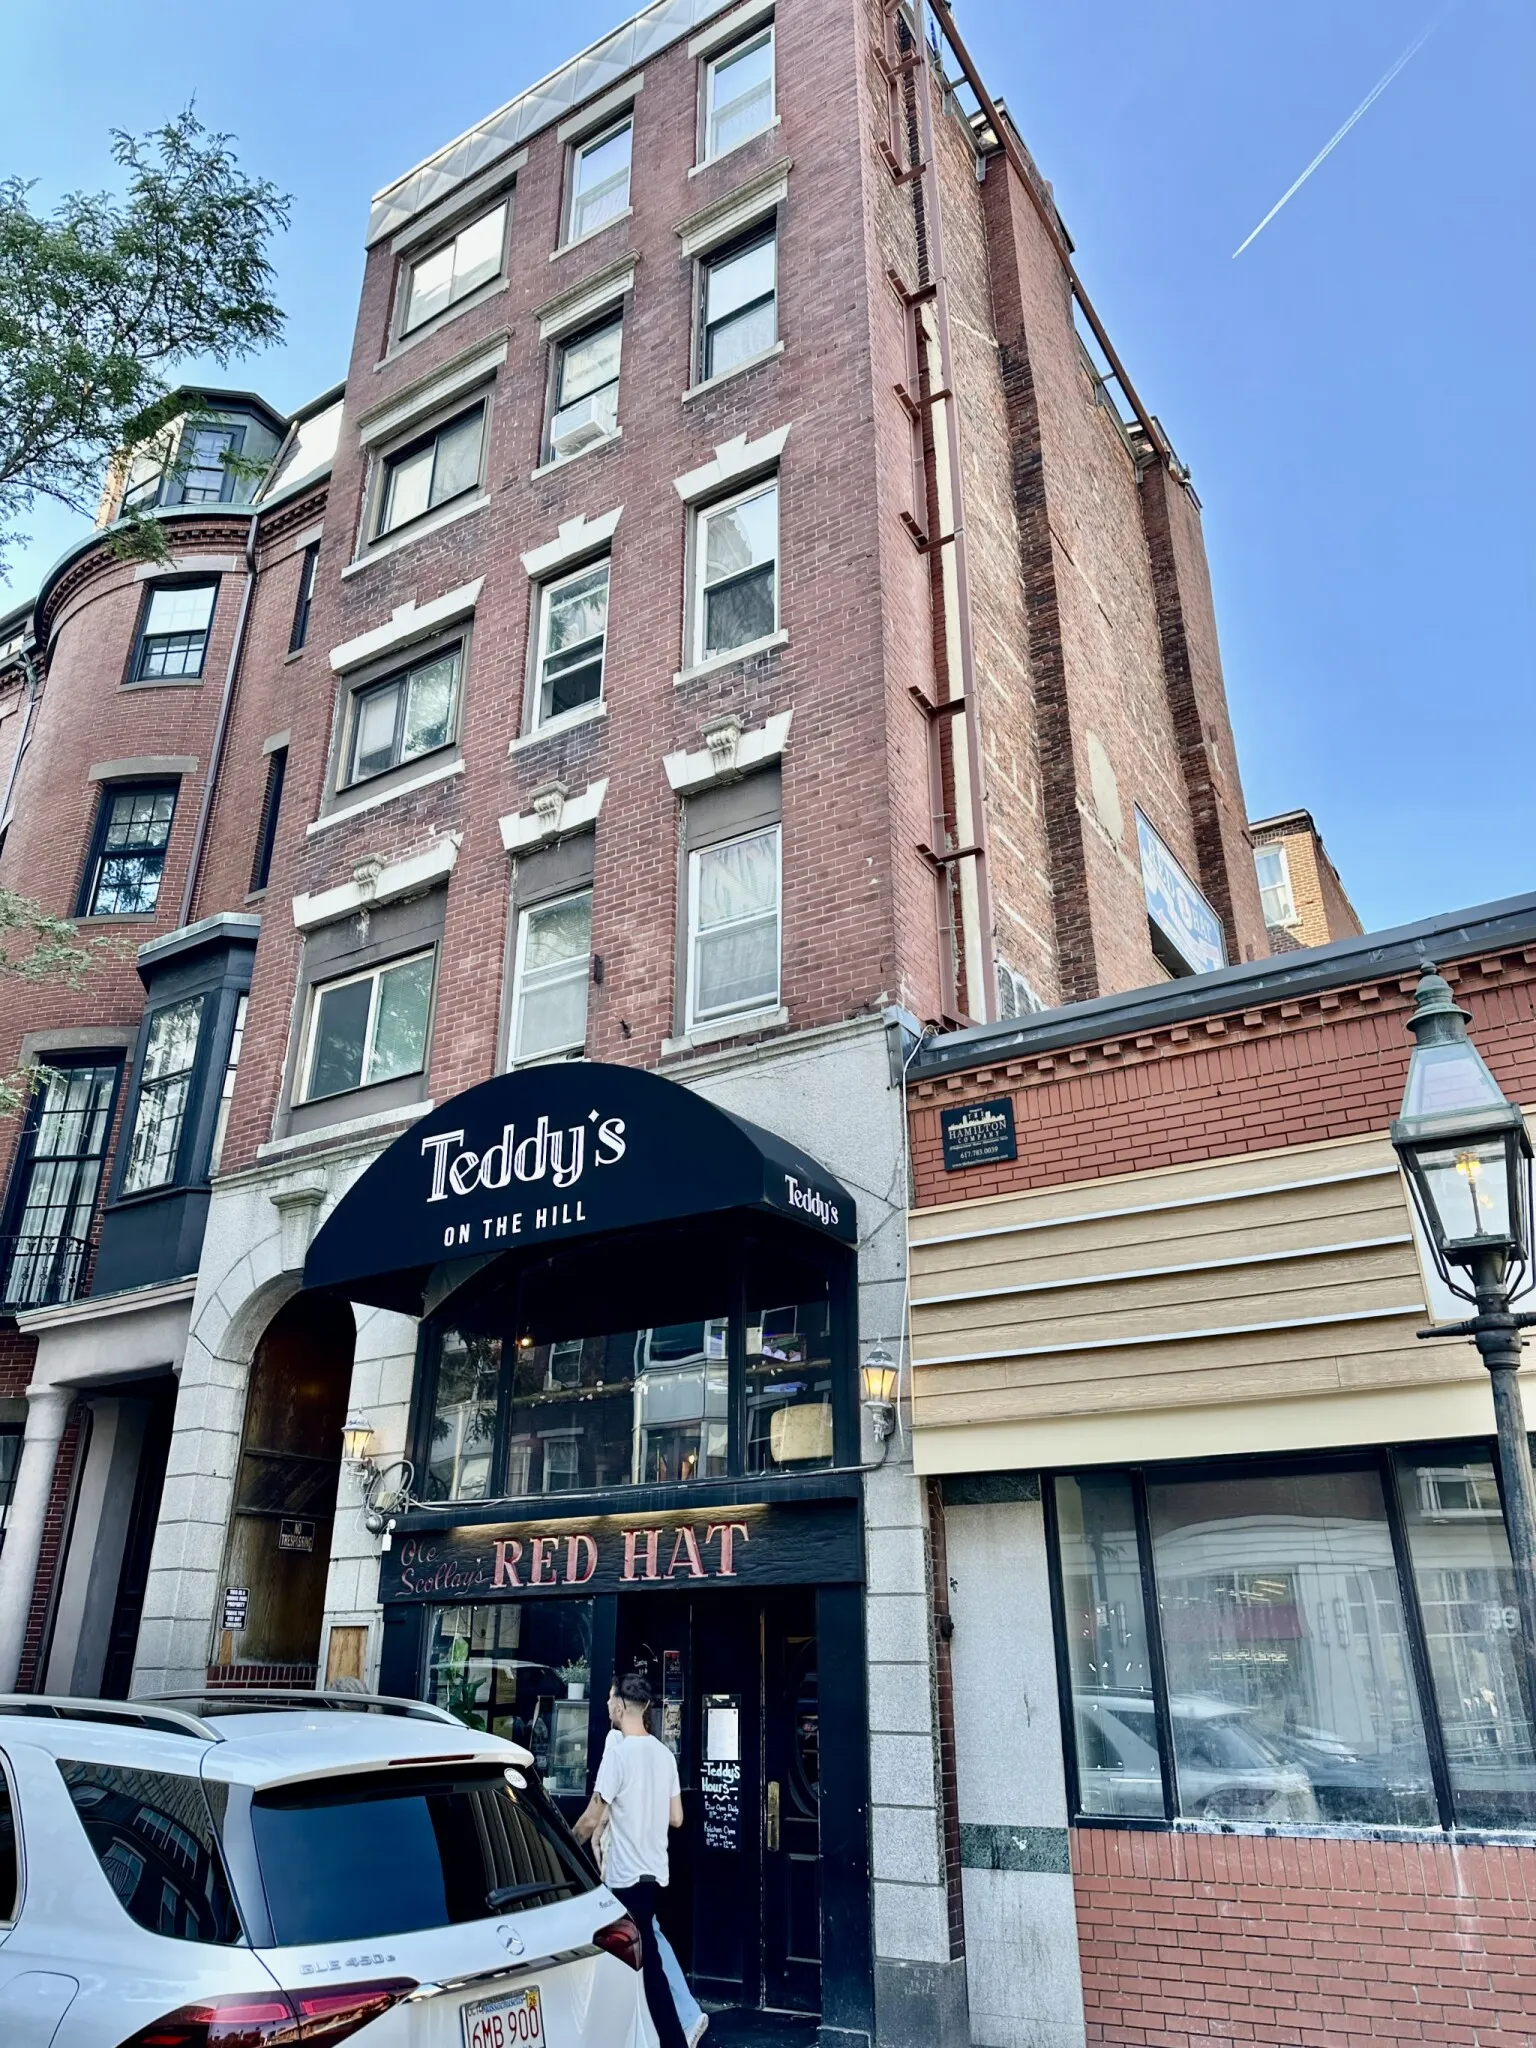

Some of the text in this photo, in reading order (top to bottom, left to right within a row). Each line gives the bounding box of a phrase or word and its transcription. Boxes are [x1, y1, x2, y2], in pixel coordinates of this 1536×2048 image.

[949, 1120, 1007, 1140] HAMILTON
[958, 1130, 1000, 1144] COMPANY
[421, 1109, 626, 1203] Teddy's
[784, 1174, 839, 1225] Teddy's
[443, 1201, 586, 1247] ON THE HILL
[281, 1534, 313, 1549] TRESPASSING
[294, 1523, 302, 1535] NO
[401, 1539, 440, 1567] Ole
[490, 1521, 749, 1589] RED HAT
[395, 1559, 490, 1597] Scollay's
[702, 1776, 729, 1794] Hours
[703, 1762, 740, 1784] Teddy's
[300, 1959, 342, 1975] GLE
[473, 2007, 540, 2048] 6MB 900
